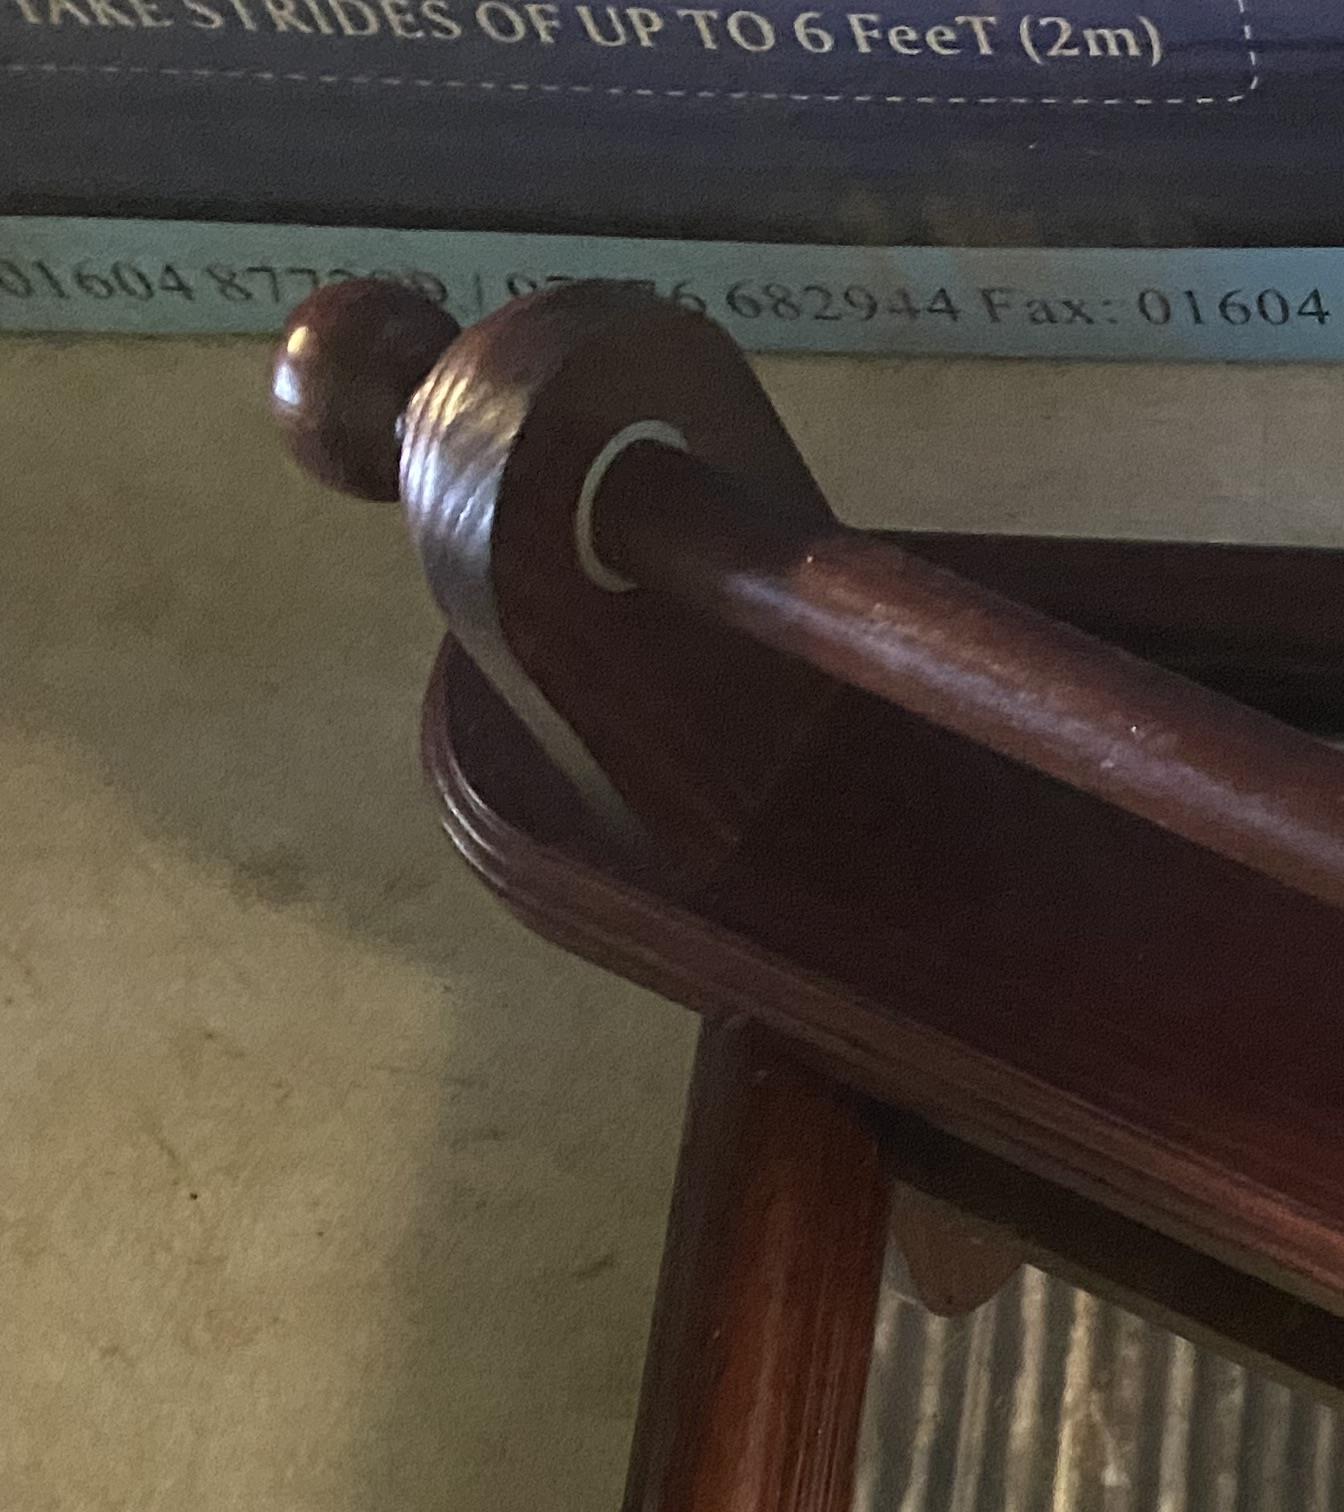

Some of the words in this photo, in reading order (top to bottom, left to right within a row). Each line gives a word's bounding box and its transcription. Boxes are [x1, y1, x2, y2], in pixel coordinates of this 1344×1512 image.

[183, 0, 462, 39] STRIDES
[474, 3, 562, 45] OF
[578, 5, 667, 47] UP
[681, 10, 775, 53] TO
[795, 15, 834, 55] 6
[850, 14, 999, 57] FeeT
[1018, 15, 1163, 66] (2m)
[725, 280, 961, 324] 682944
[981, 288, 1118, 325] Fax:
[1137, 287, 1329, 328] 01604
